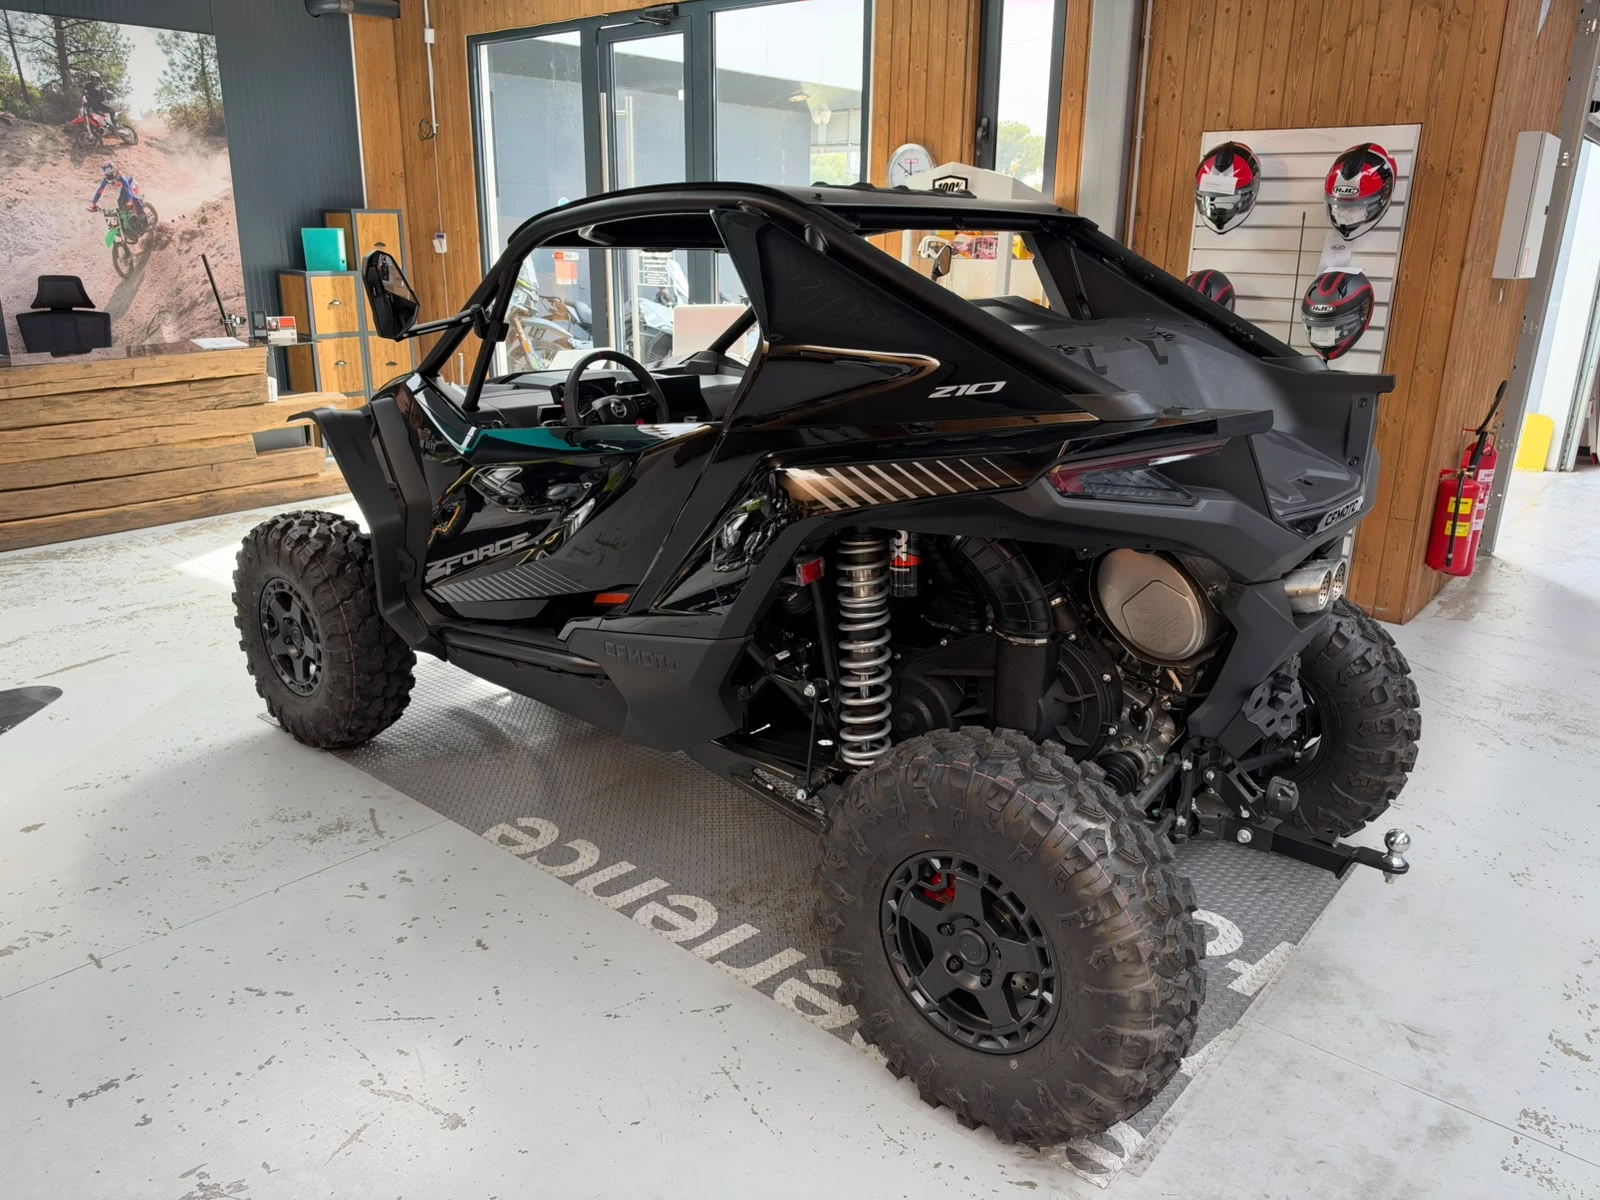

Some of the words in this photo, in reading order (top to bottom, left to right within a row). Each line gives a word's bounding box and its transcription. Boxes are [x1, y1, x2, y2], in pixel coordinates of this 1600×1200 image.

[1335, 186, 1358, 195] HJC
[1311, 304, 1333, 312] HJC
[928, 381, 1007, 398] Z10
[425, 532, 532, 583] ZFORCE
